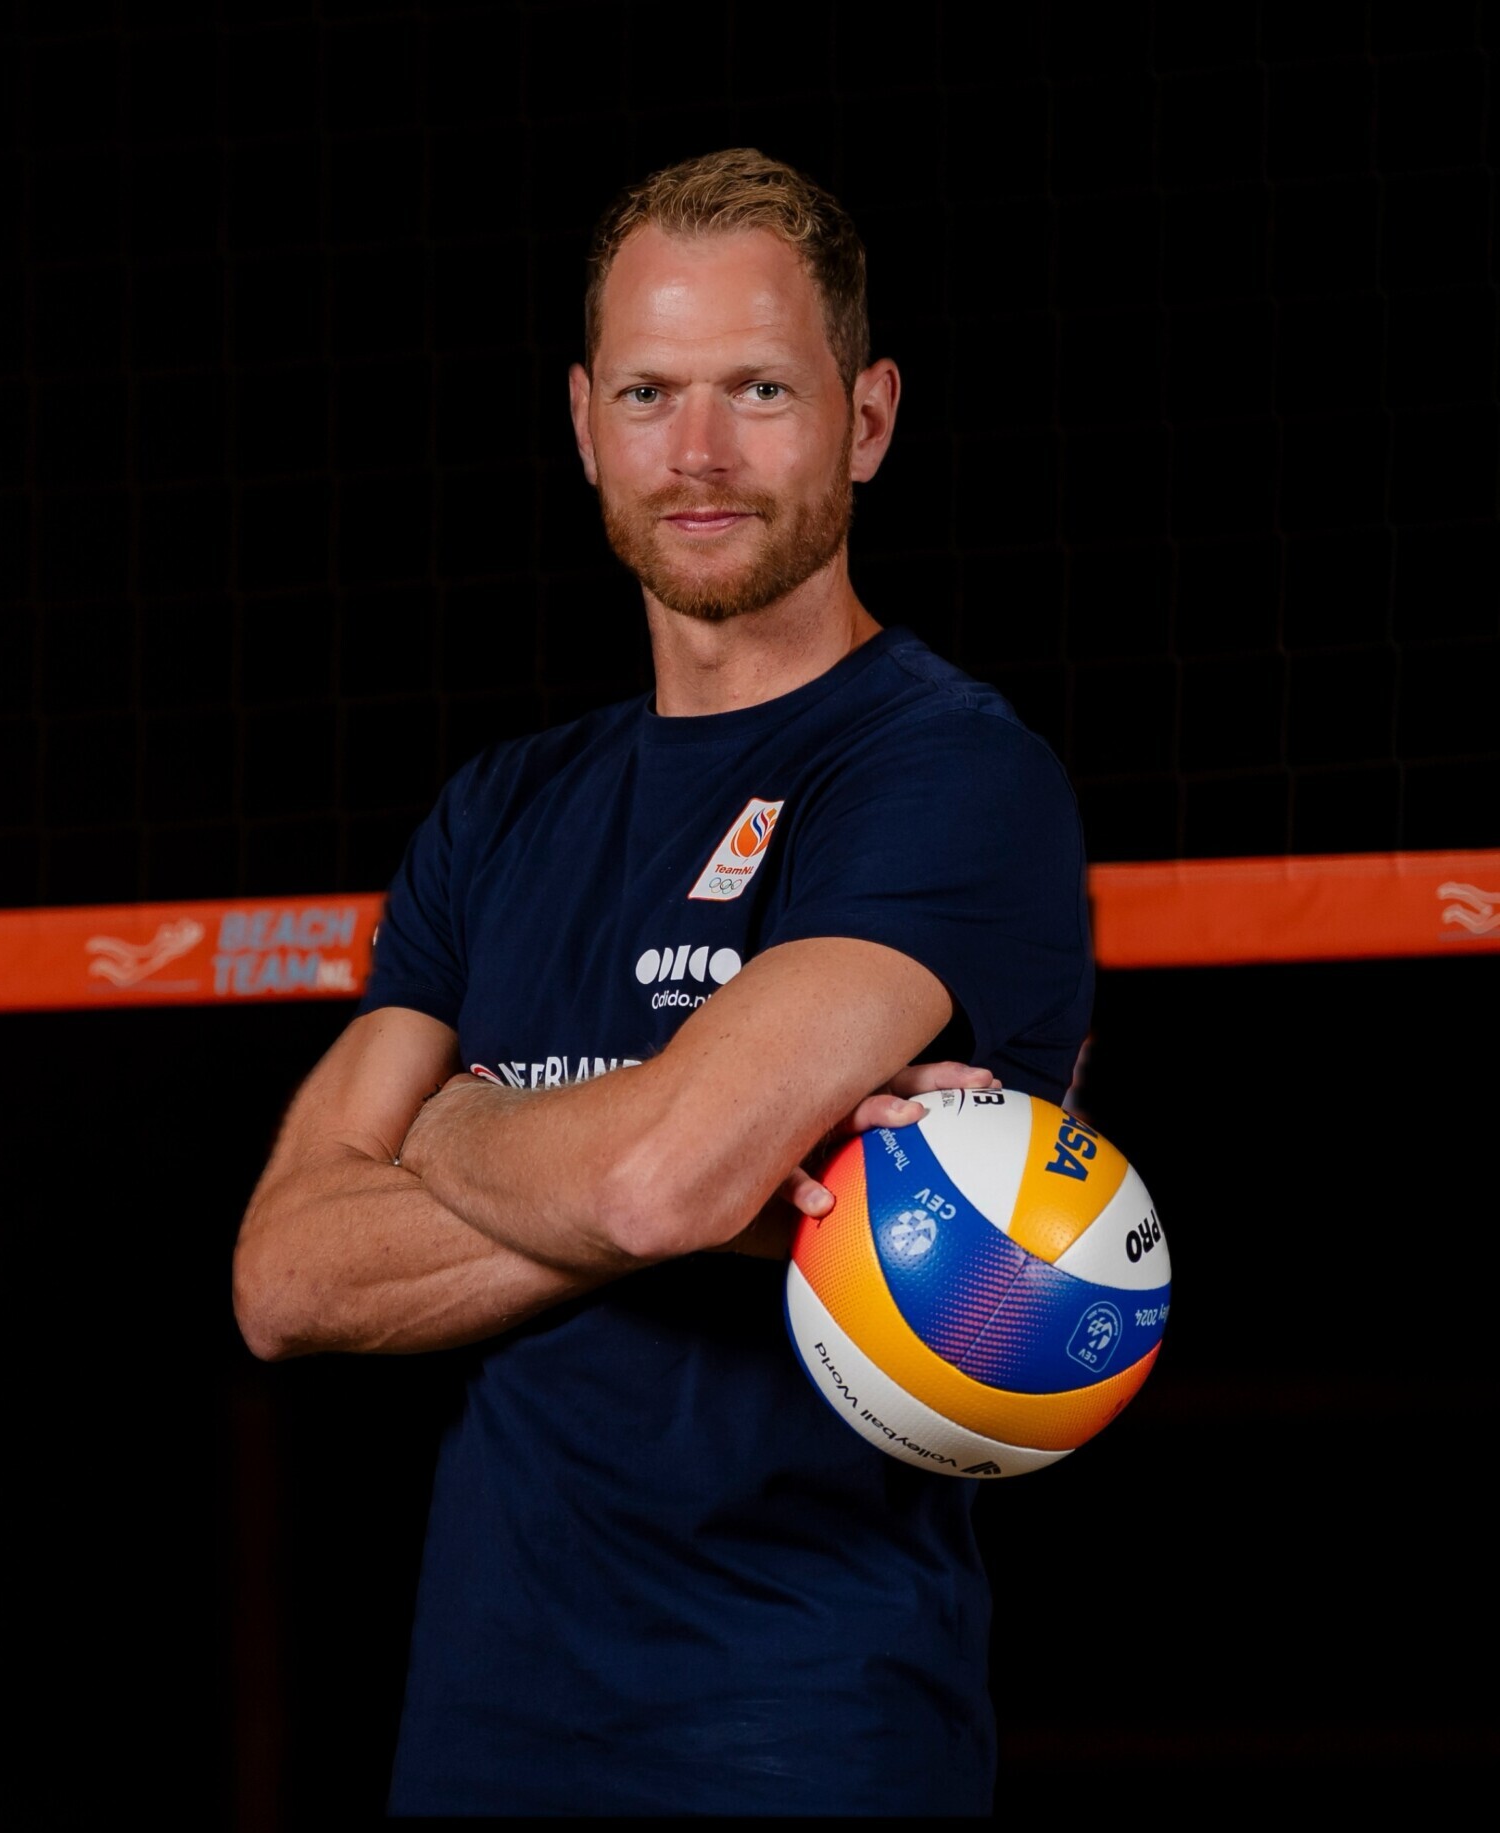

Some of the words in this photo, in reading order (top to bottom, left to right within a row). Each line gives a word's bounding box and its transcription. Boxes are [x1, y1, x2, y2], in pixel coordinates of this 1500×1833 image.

[217, 909, 357, 949] BEACH
[913, 1187, 957, 1220] CEV
[1126, 1208, 1161, 1263] PRO
[814, 1342, 858, 1409] World
[1078, 1348, 1098, 1364] CEV
[860, 1409, 958, 1468] Volleyball
